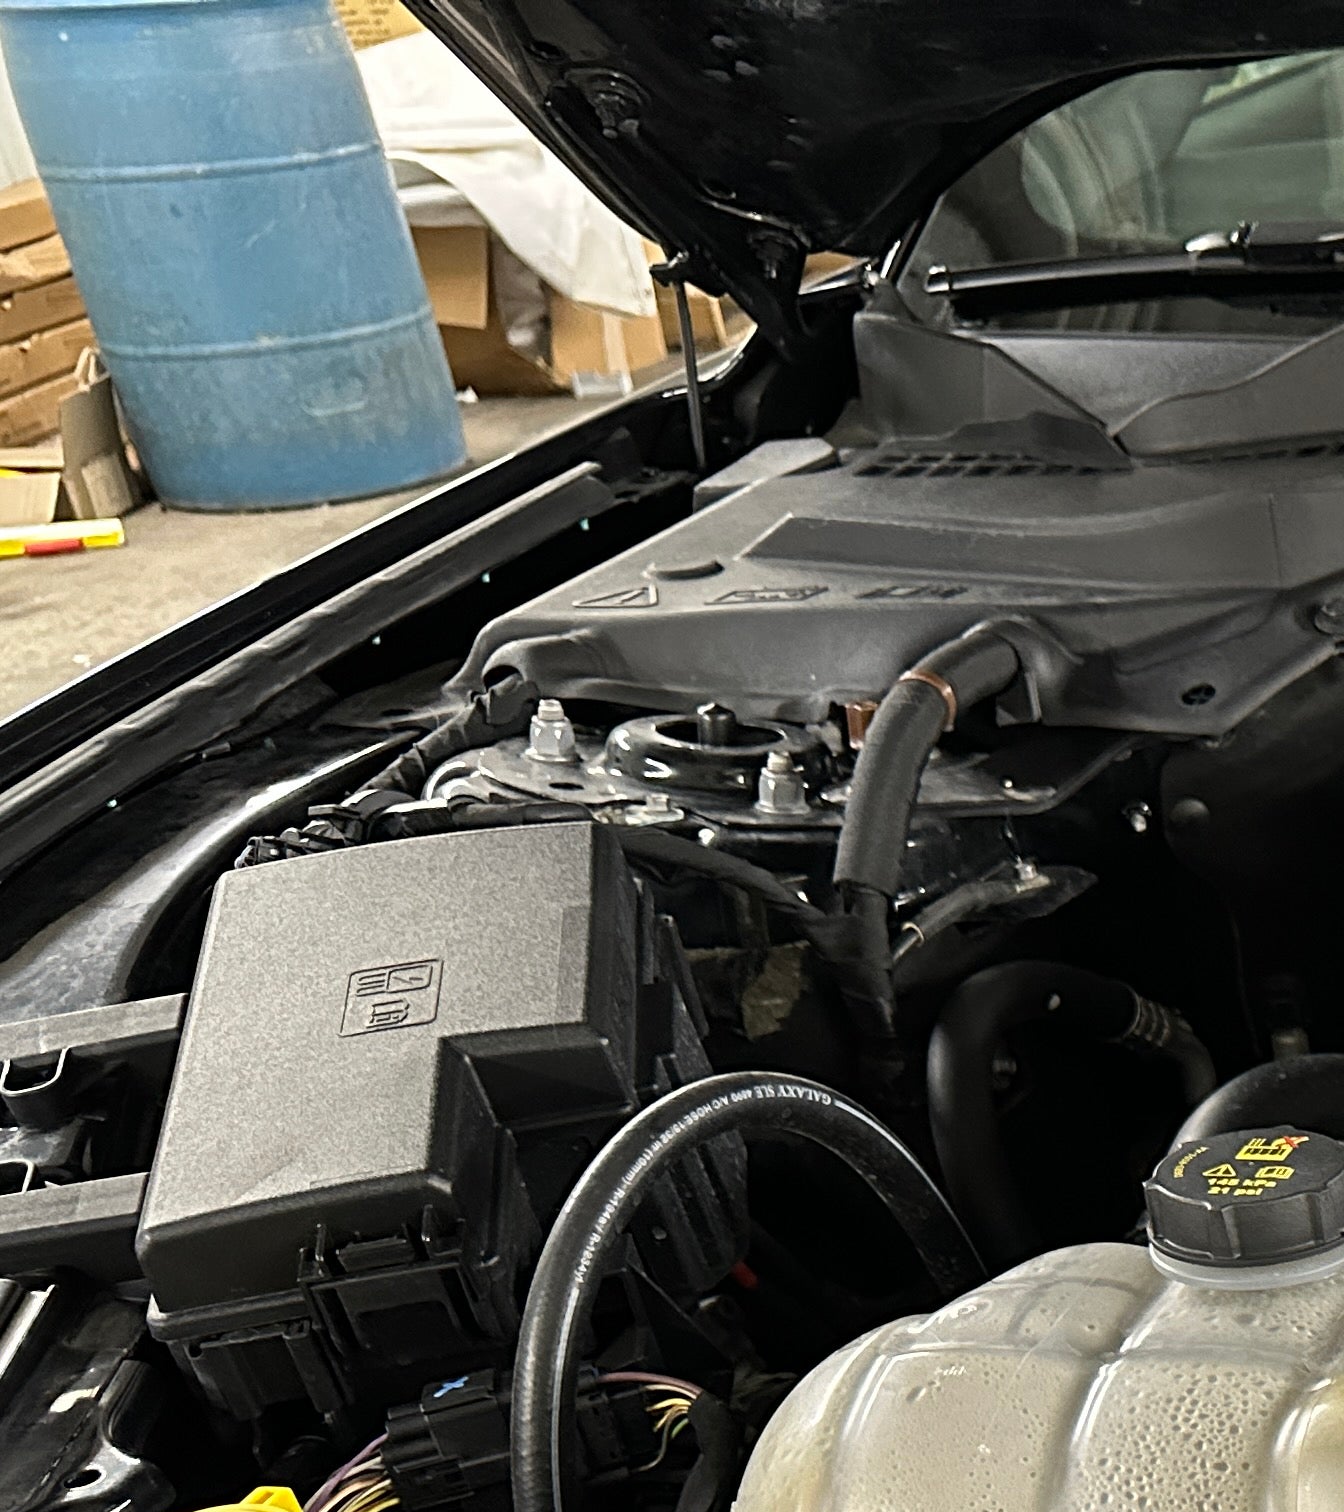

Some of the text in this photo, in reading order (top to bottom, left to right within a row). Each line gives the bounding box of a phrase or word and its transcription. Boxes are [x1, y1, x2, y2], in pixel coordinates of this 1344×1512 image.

[754, 1084, 775, 1099] SLE
[778, 1084, 832, 1105] GALAXY
[711, 1095, 729, 1110] A/C
[683, 1102, 712, 1125] HOSE
[621, 1147, 655, 1184] (10mm)
